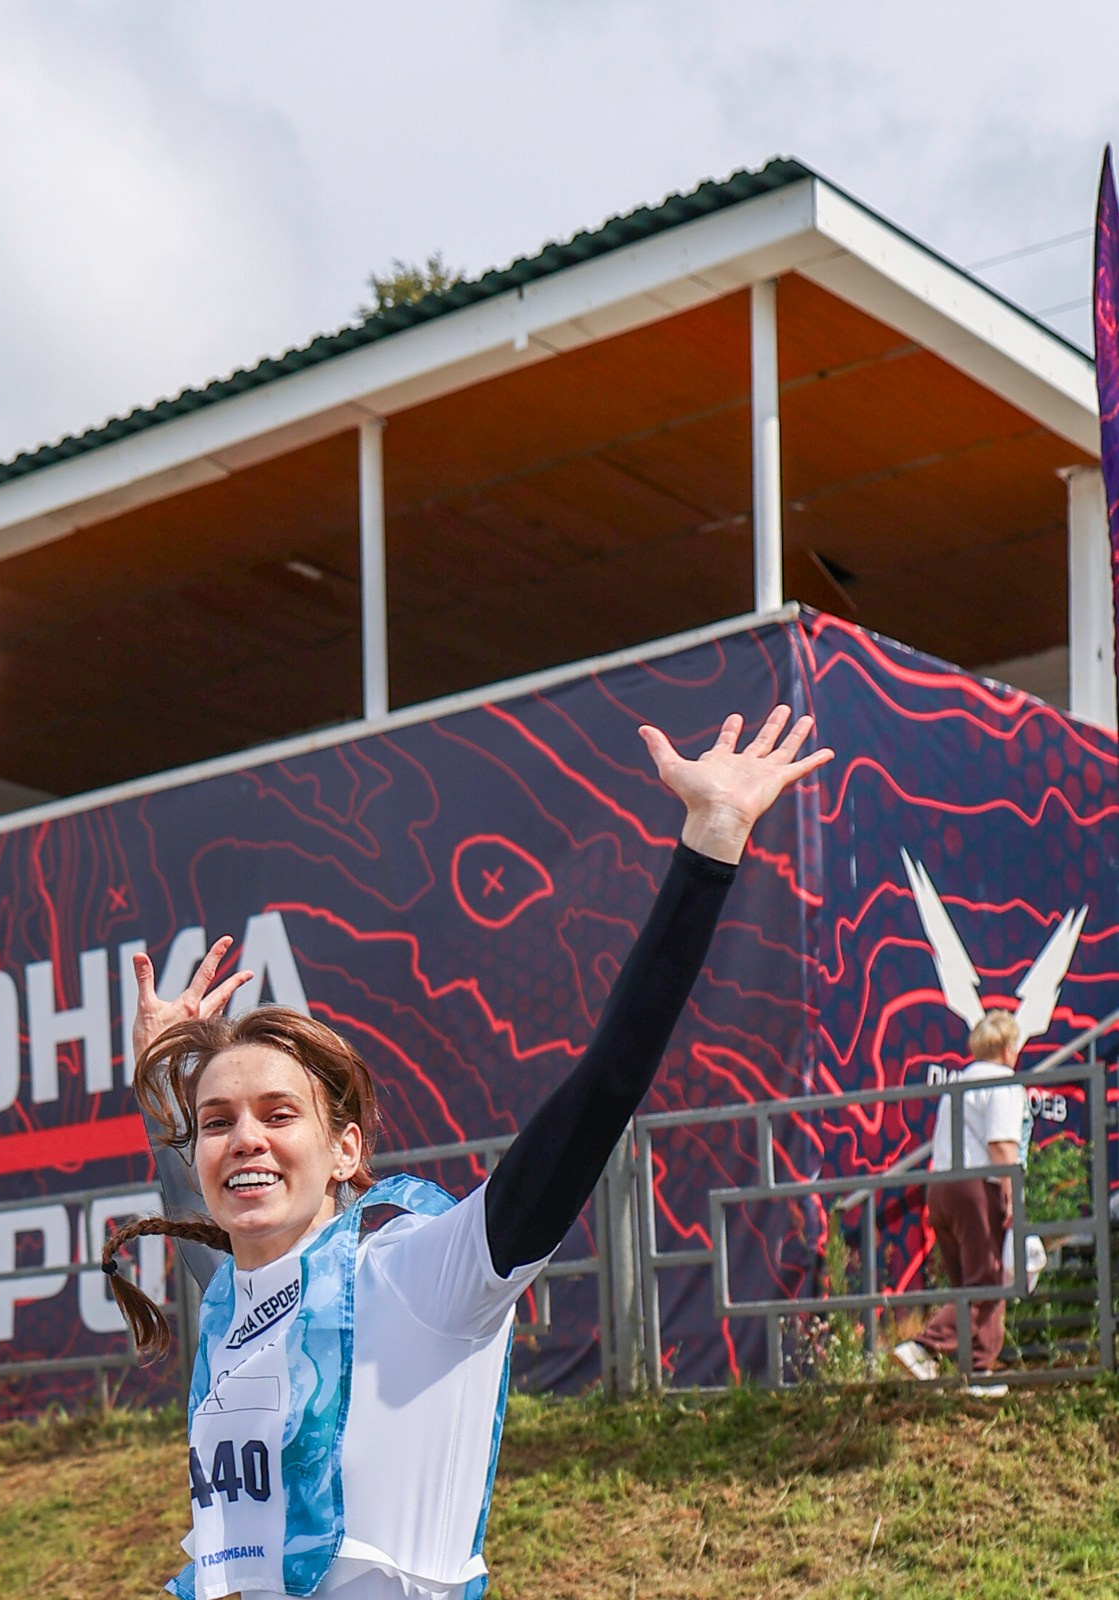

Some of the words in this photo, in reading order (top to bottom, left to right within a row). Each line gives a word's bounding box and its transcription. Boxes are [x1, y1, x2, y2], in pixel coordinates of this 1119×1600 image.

[1027, 1087, 1068, 1122] ОЕВ
[253, 1278, 300, 1325] ГЕРОЕВ
[189, 1440, 271, 1508] 440
